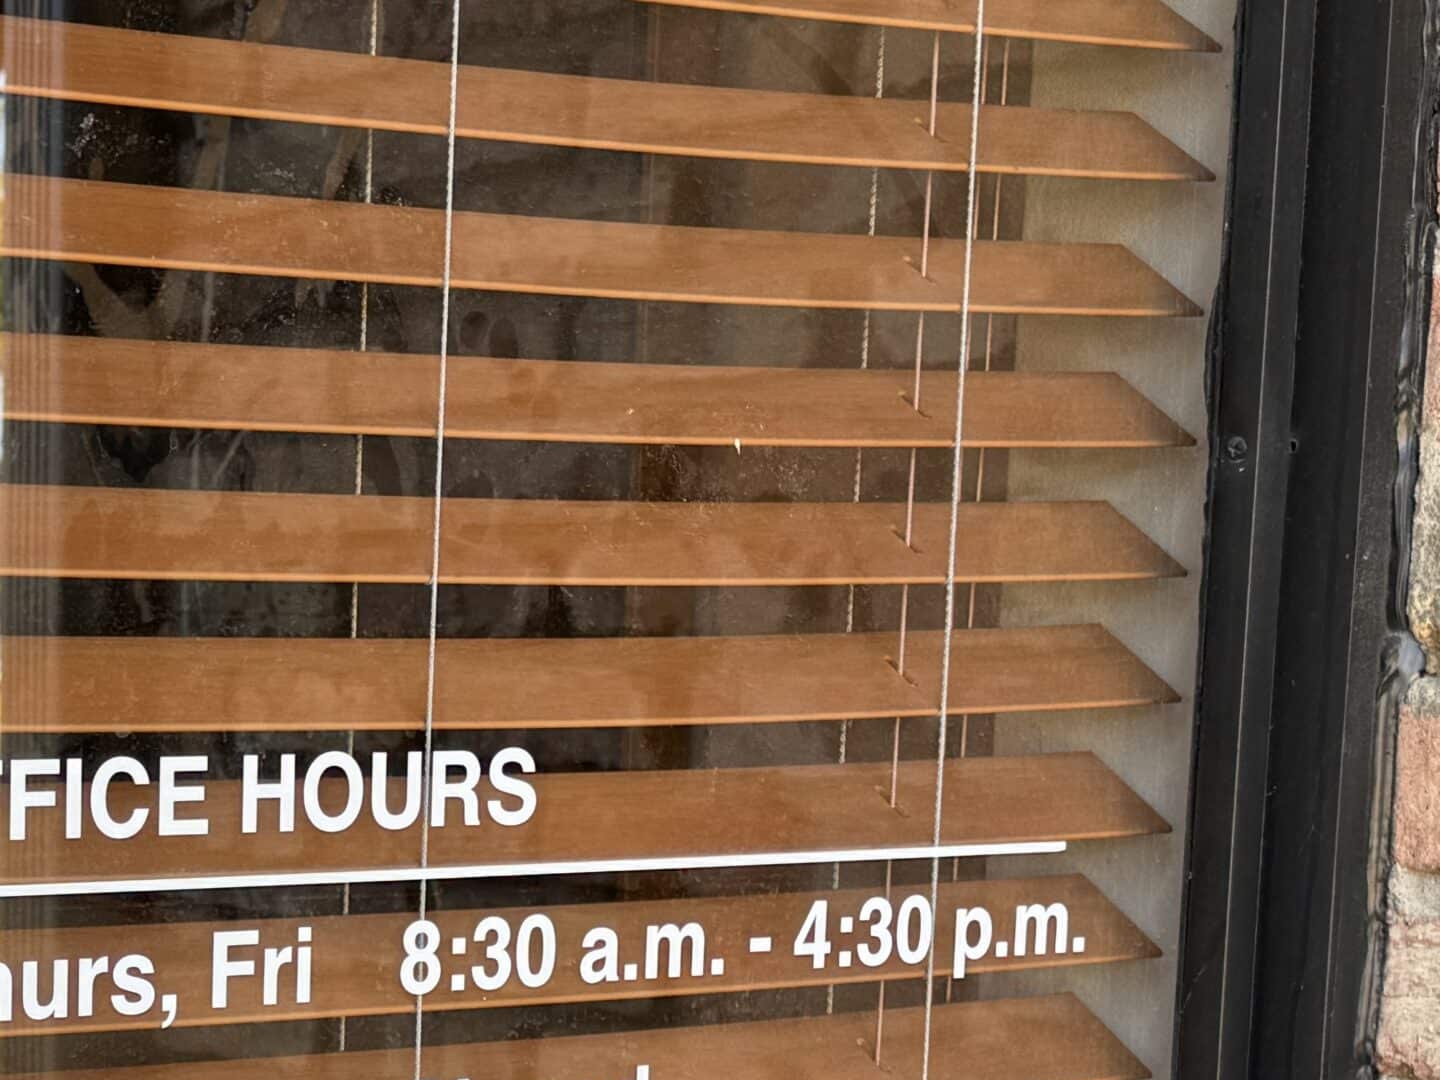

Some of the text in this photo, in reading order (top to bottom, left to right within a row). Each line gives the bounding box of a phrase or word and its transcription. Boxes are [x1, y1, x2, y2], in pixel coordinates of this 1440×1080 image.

[241, 746, 537, 833] HOURS
[211, 926, 313, 1009] Fri
[400, 913, 557, 996] 8:30
[580, 918, 725, 983] a.m.
[749, 935, 773, 953] -
[793, 894, 933, 969] 4:30
[952, 900, 1087, 979] p.m.
